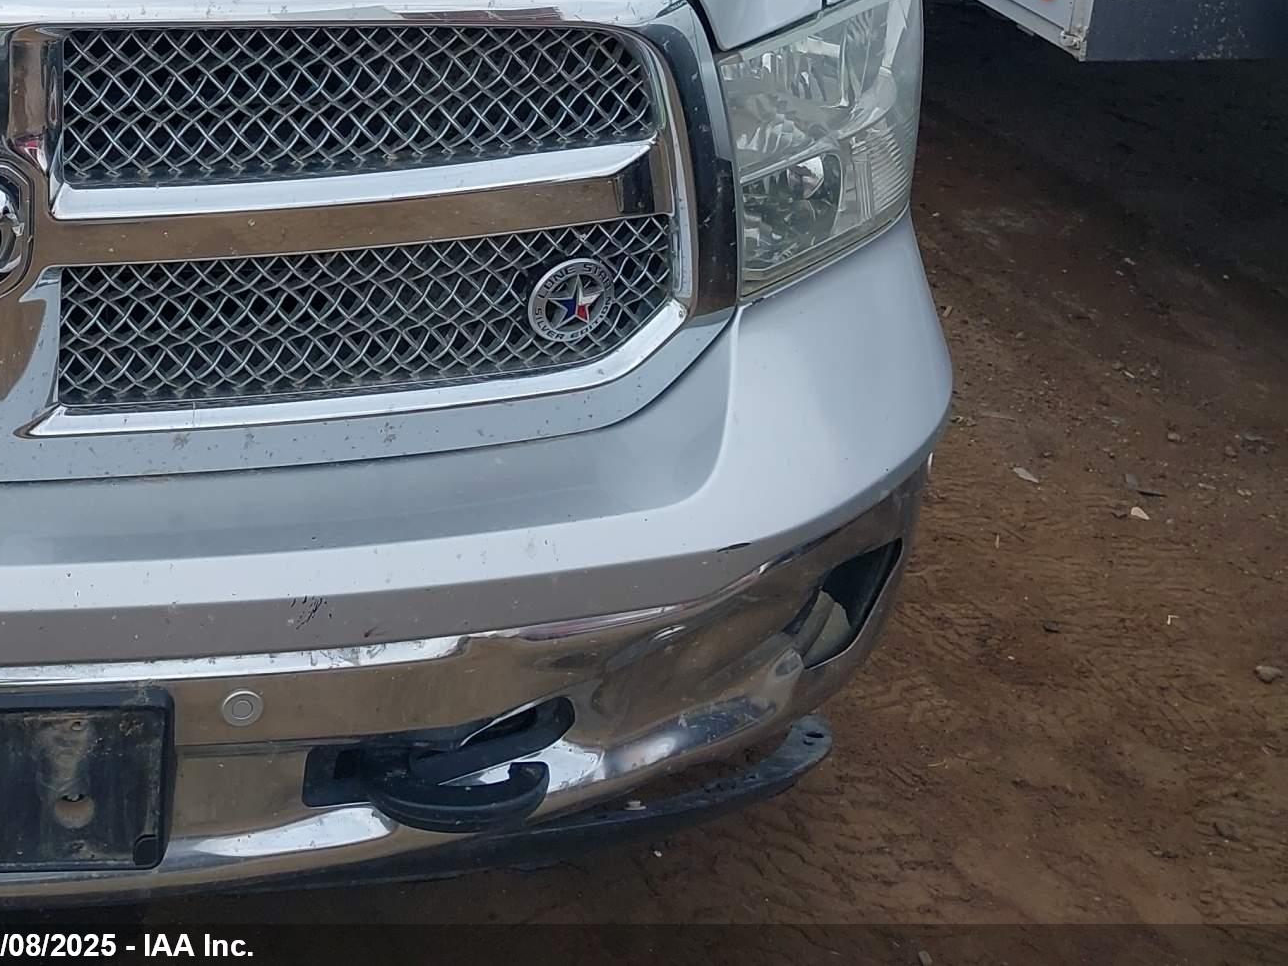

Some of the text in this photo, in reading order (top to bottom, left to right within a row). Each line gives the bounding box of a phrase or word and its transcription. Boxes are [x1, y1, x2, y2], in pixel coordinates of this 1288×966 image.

[538, 264, 612, 299] LONE STAR
[535, 296, 612, 339] SILVER EDITION
